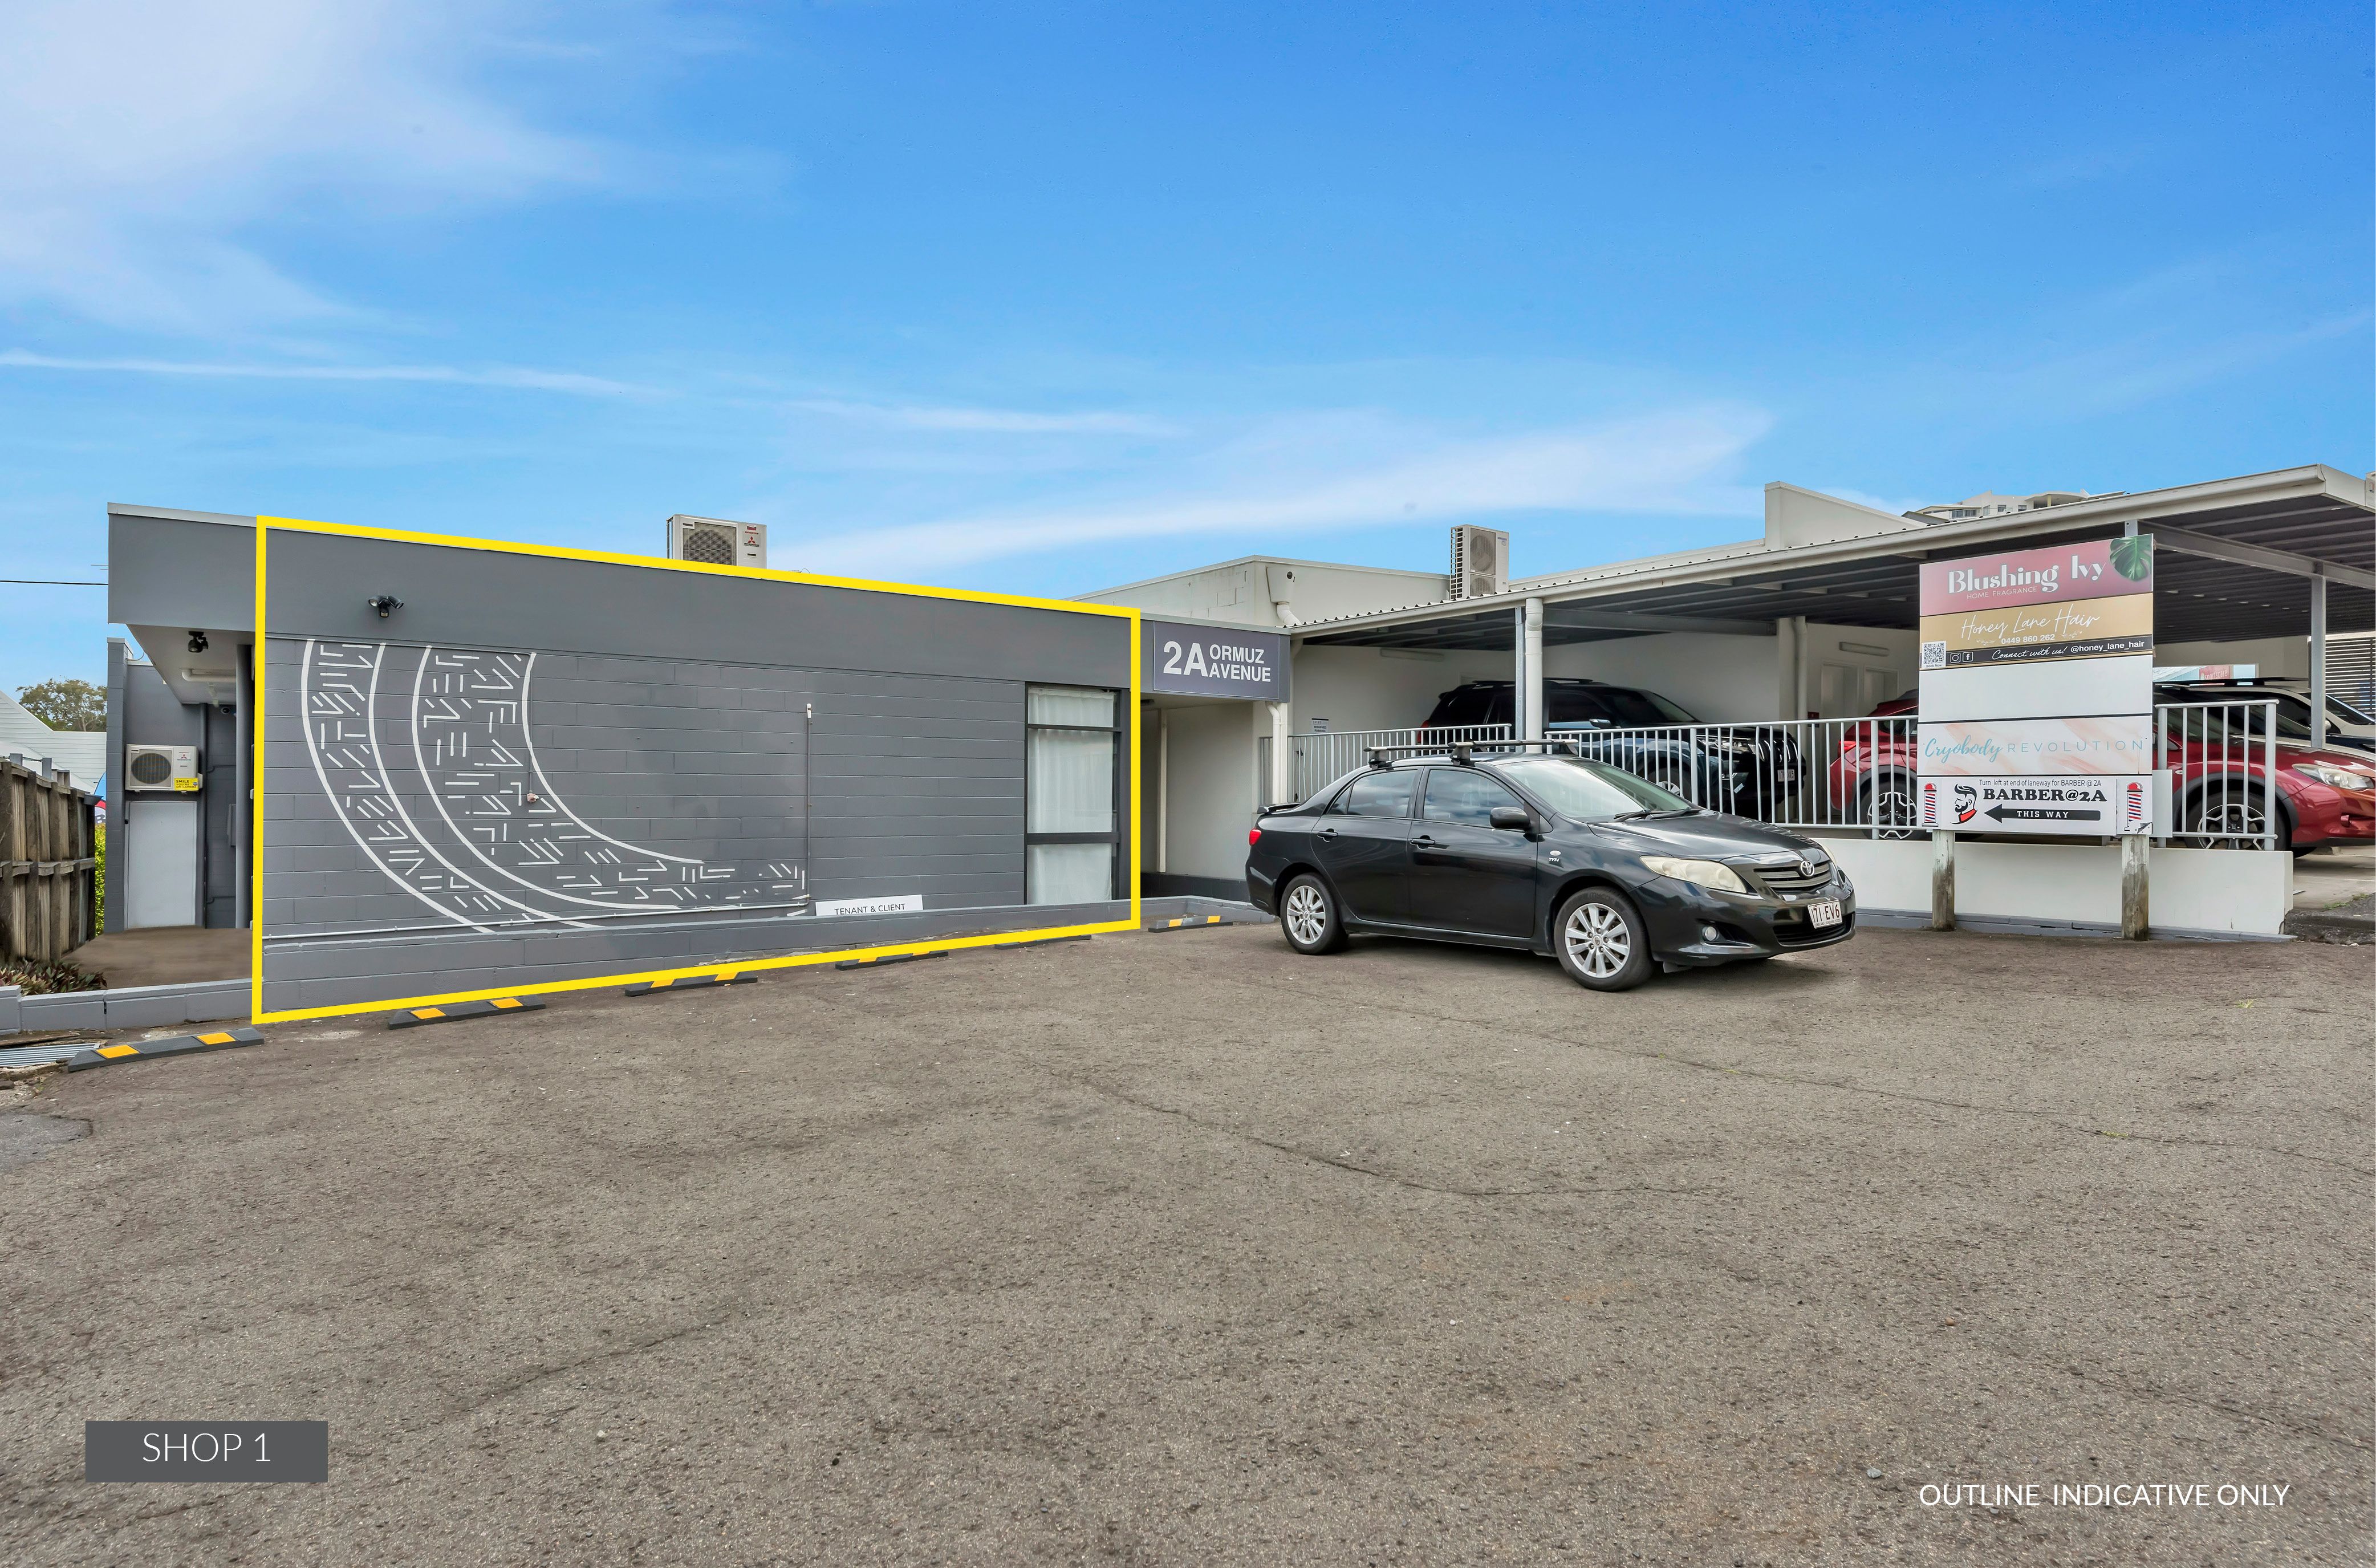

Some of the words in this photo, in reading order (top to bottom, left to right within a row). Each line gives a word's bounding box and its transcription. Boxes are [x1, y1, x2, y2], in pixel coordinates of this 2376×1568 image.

[1949, 564, 2060, 592] Blushing
[2072, 555, 2106, 580] Ivy
[1993, 586, 2037, 596] FRAGRANCE
[1961, 615, 2009, 640] Honey
[2013, 611, 2051, 633] Lane
[2054, 603, 2101, 634] Hair
[1163, 641, 1208, 677] 2A
[1209, 644, 1264, 664] ORMUZ
[1992, 649, 2027, 660] Connect
[2029, 647, 2050, 657] with
[2070, 640, 2145, 653] @honey_lane_hair
[1209, 663, 1271, 682] AVENUE
[1924, 735, 2004, 763] Cryobody
[2008, 740, 2143, 753] REVOLUTION
[1983, 789, 2107, 802] BARBER@2A
[835, 906, 868, 915] TENANT
[878, 903, 905, 912] CLIENT
